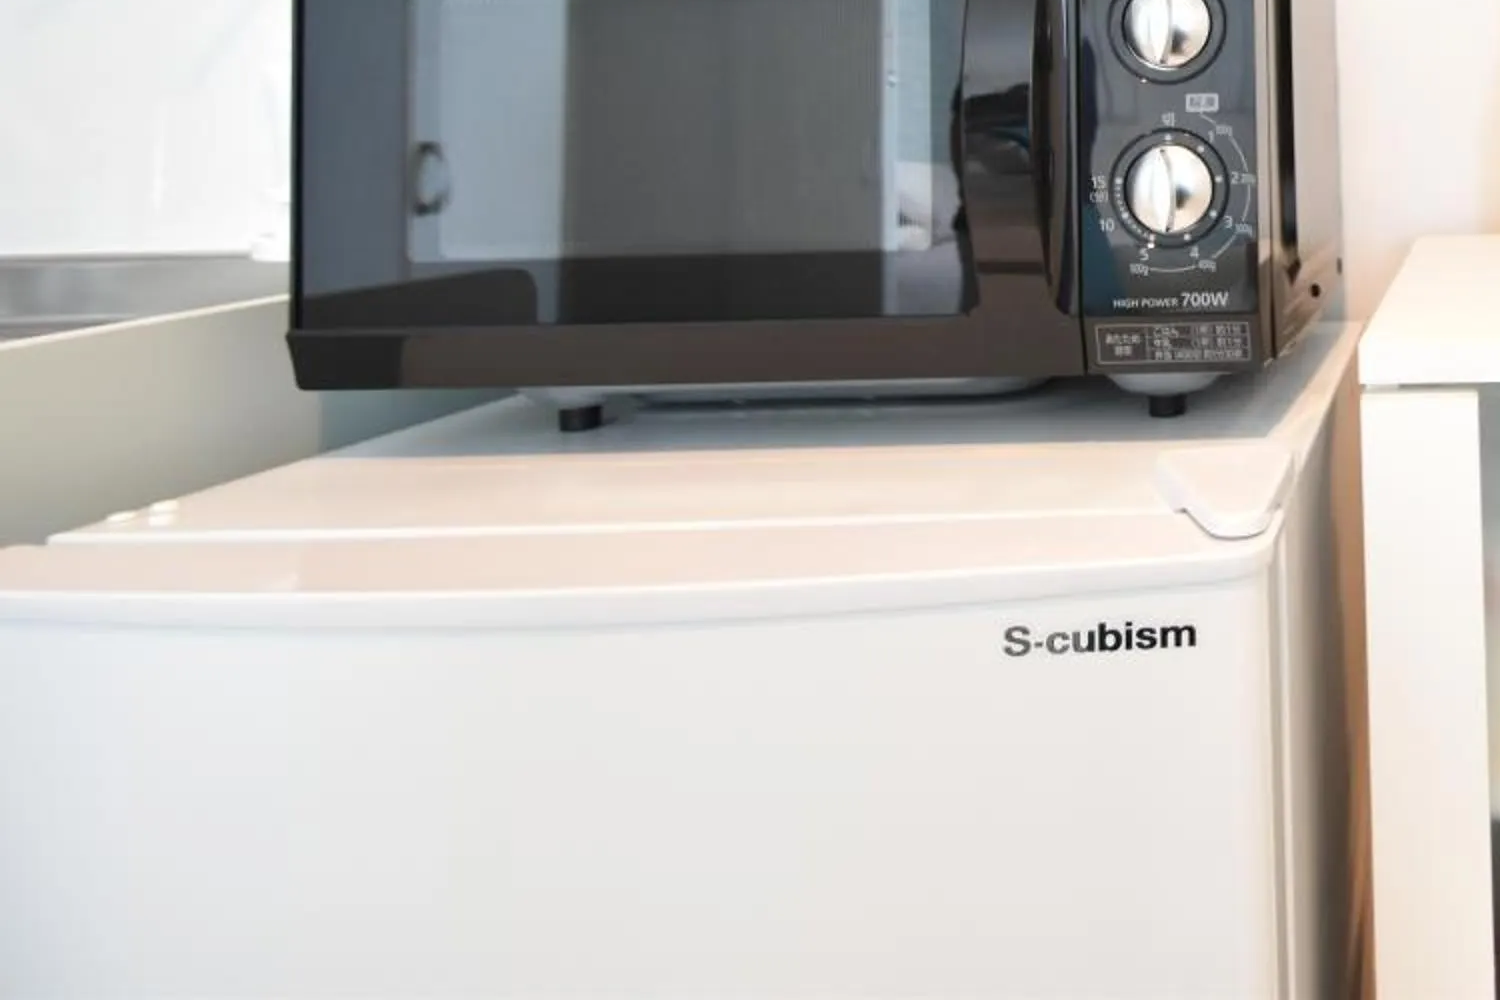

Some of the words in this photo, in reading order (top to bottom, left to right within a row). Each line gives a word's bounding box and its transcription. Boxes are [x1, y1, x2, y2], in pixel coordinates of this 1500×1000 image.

[1113, 299, 1138, 309] HIGH
[1142, 298, 1179, 309] POWER
[1180, 291, 1229, 308] 700W
[1003, 621, 1197, 657] S-cubism
